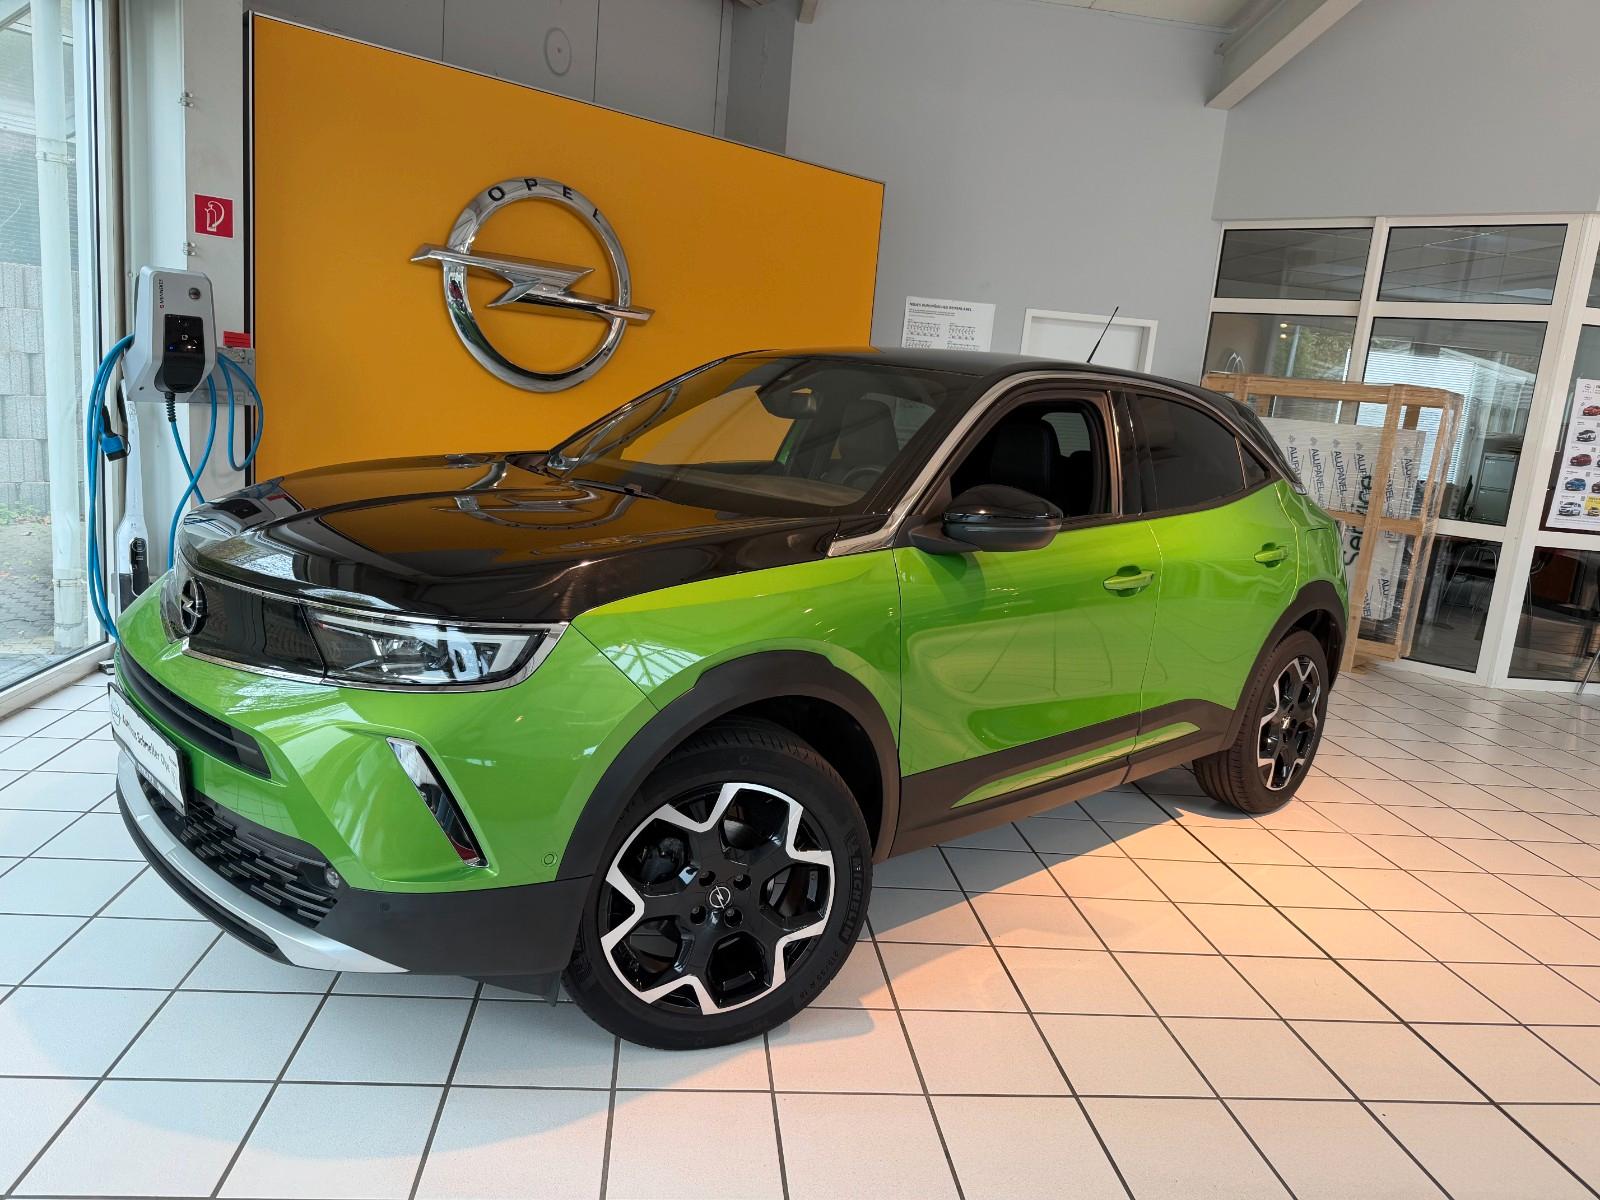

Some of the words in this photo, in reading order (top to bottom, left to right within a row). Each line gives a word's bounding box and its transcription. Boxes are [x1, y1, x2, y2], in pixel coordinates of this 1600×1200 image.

[488, 178, 601, 223] OPEL
[1311, 448, 1324, 492] ALUPANEL
[1334, 451, 1347, 492] ALUPANEL
[843, 857, 864, 941] MICHELIN
